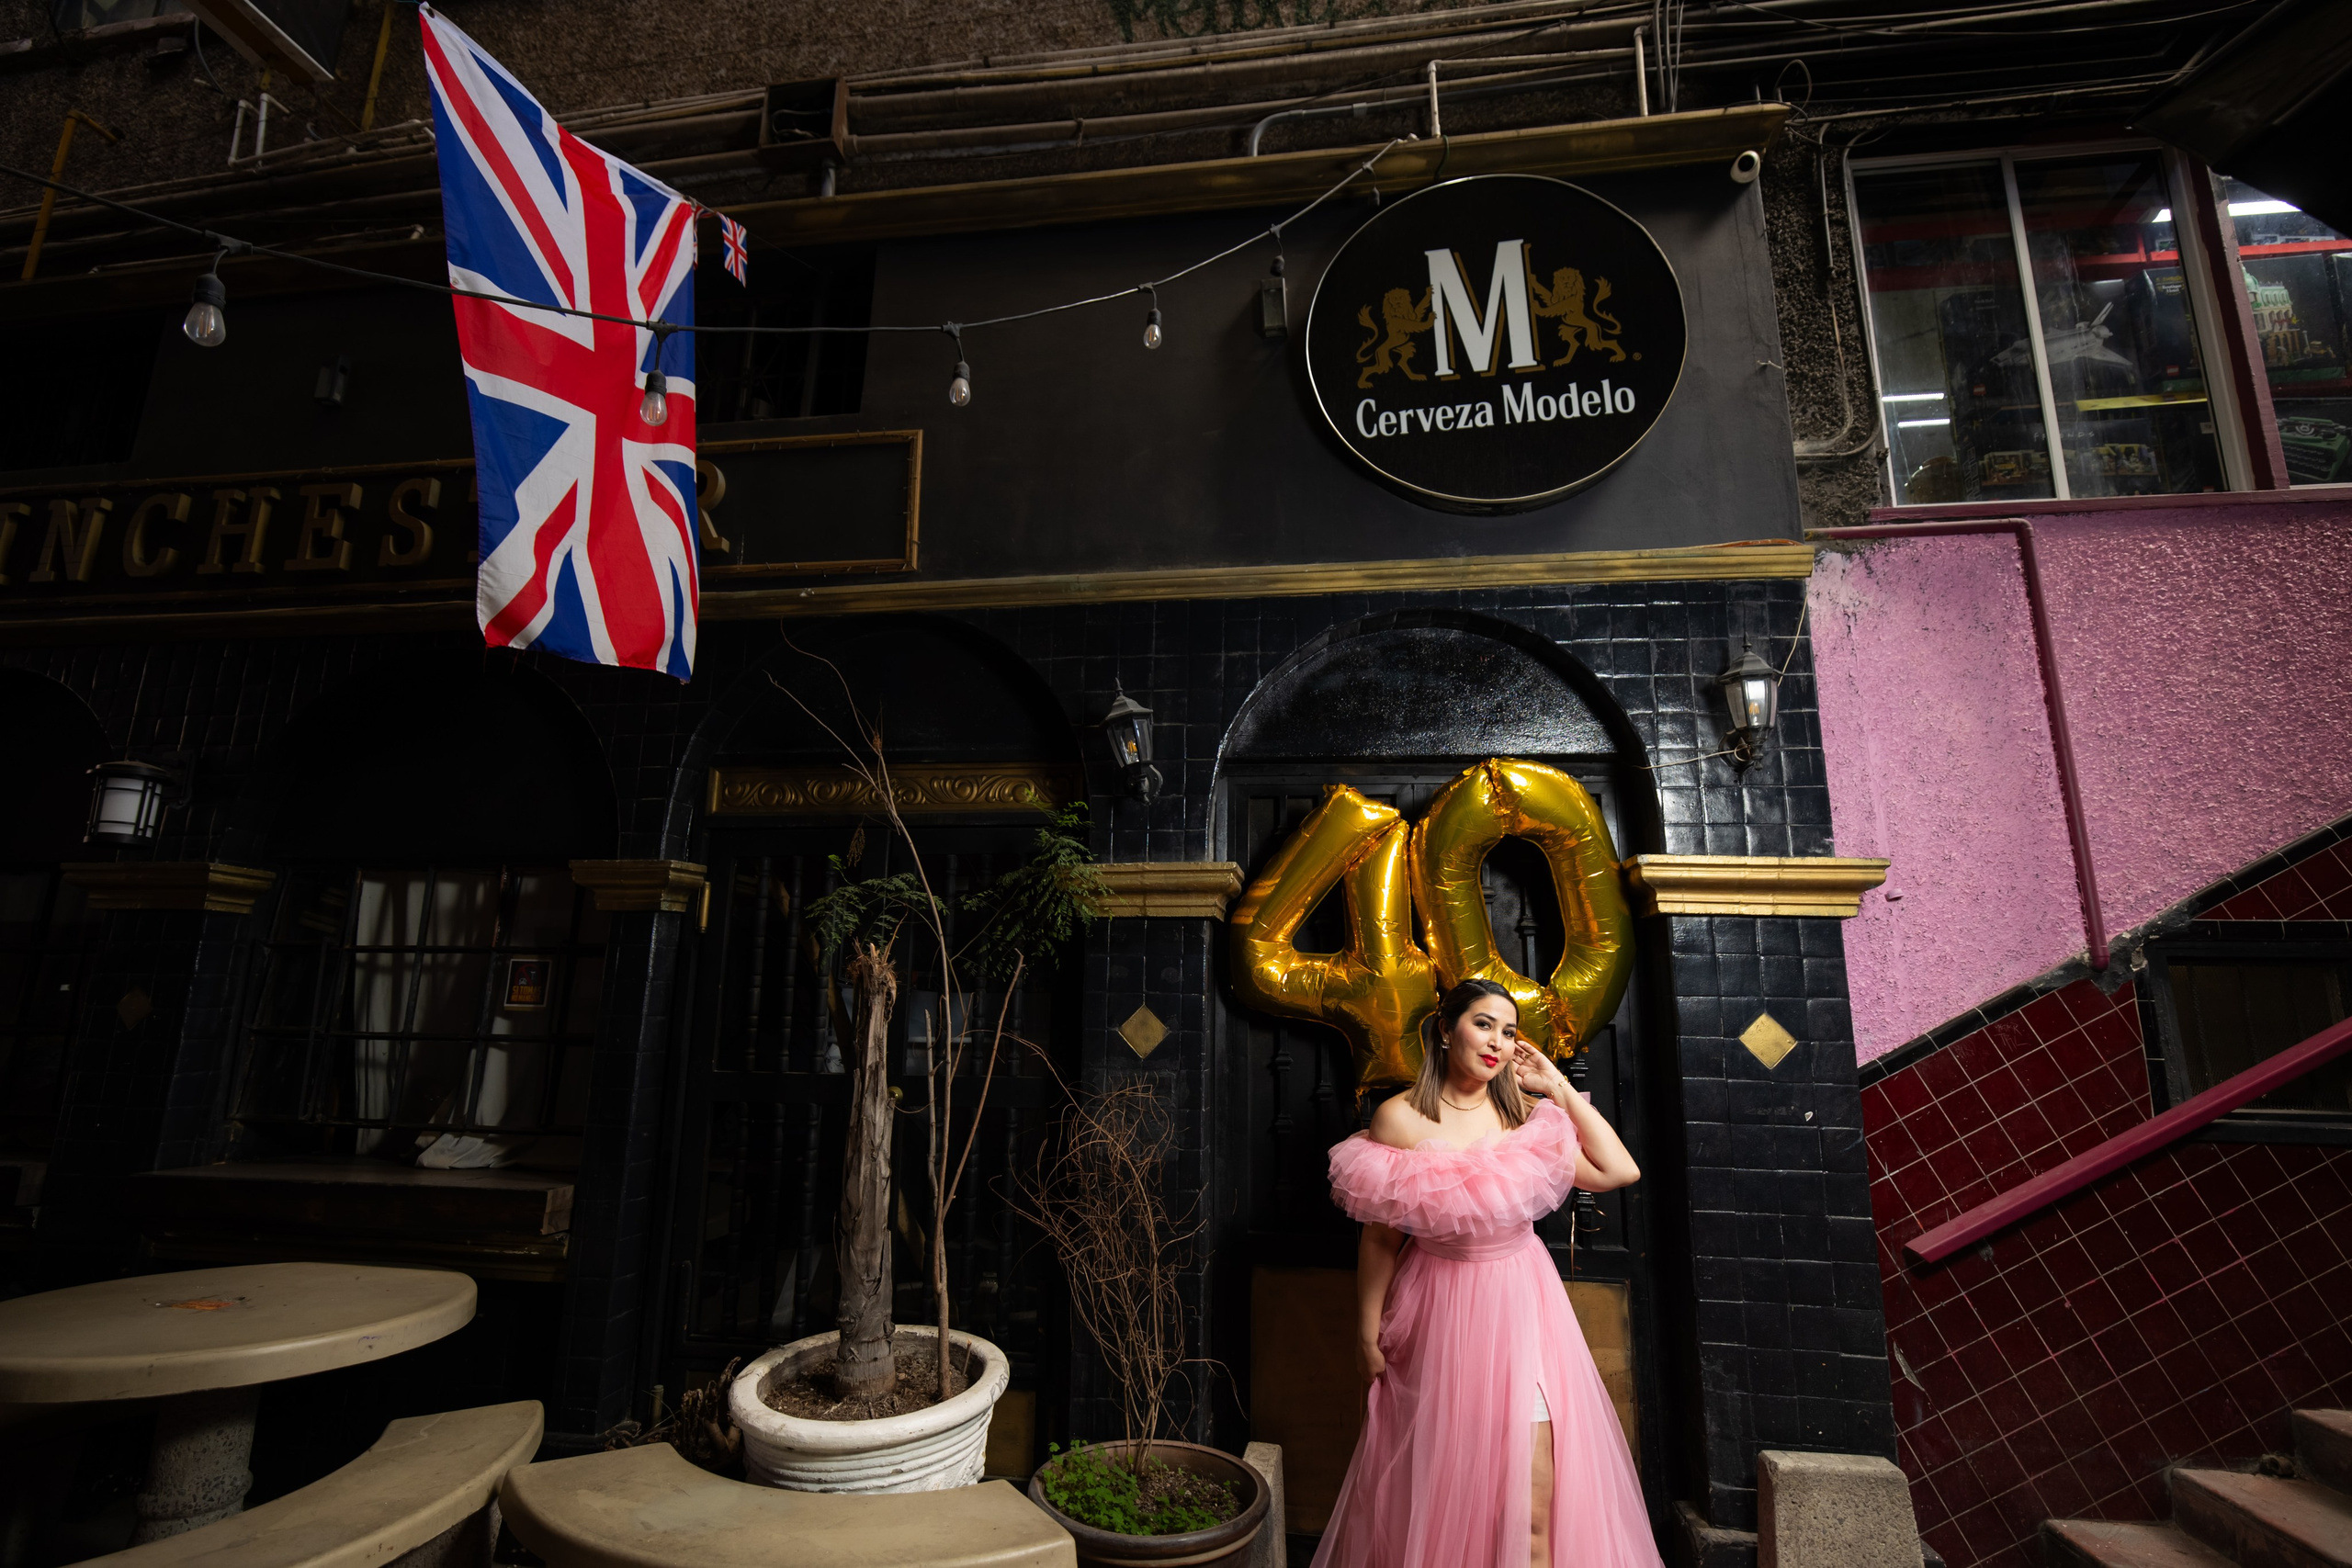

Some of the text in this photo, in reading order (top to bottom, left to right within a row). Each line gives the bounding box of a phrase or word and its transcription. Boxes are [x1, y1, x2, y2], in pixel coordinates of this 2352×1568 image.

[1424, 238, 1544, 379] M
[1355, 378, 1636, 439] Cerveza Modelo
